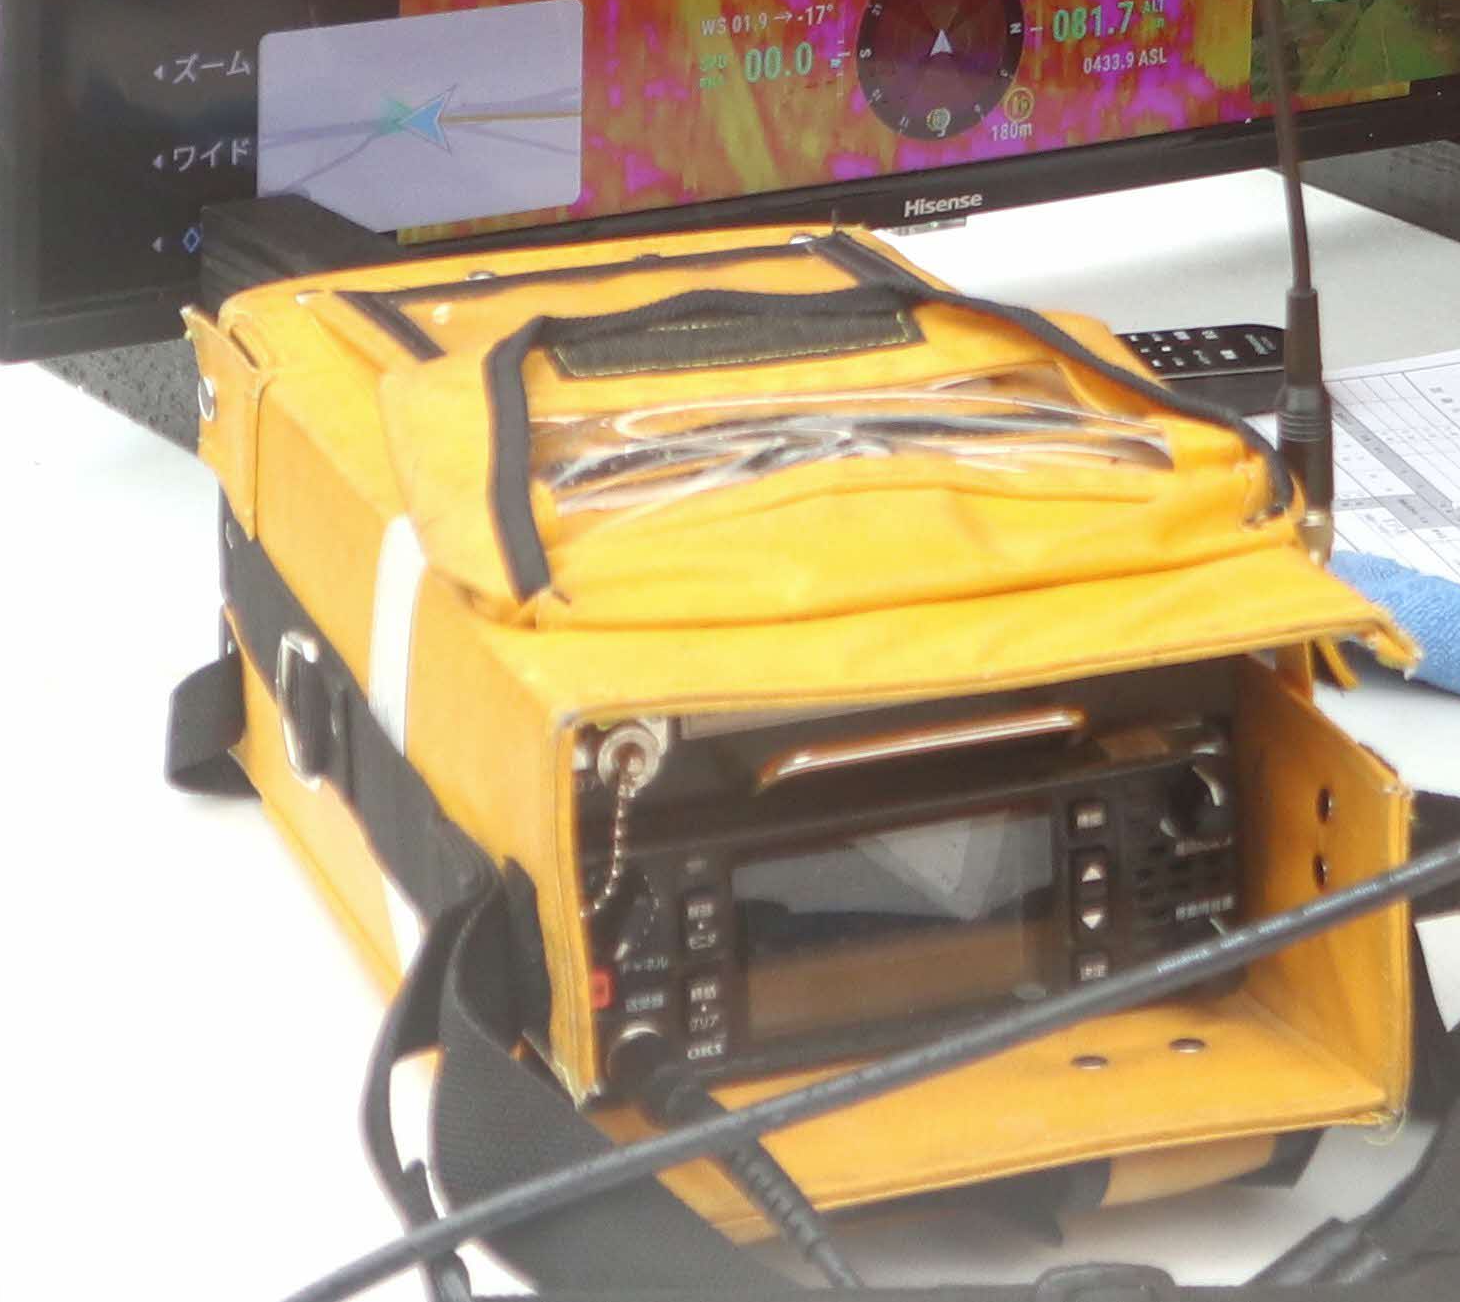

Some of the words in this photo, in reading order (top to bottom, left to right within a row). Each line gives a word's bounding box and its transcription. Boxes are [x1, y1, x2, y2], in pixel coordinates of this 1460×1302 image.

[1052, 0, 1135, 42] 081.7
[172, 49, 252, 85] ズーム
[744, 41, 813, 84] 00.0
[1138, 46, 1168, 67] ASL
[172, 137, 251, 173] ワイド
[903, 192, 984, 219] Hisense
